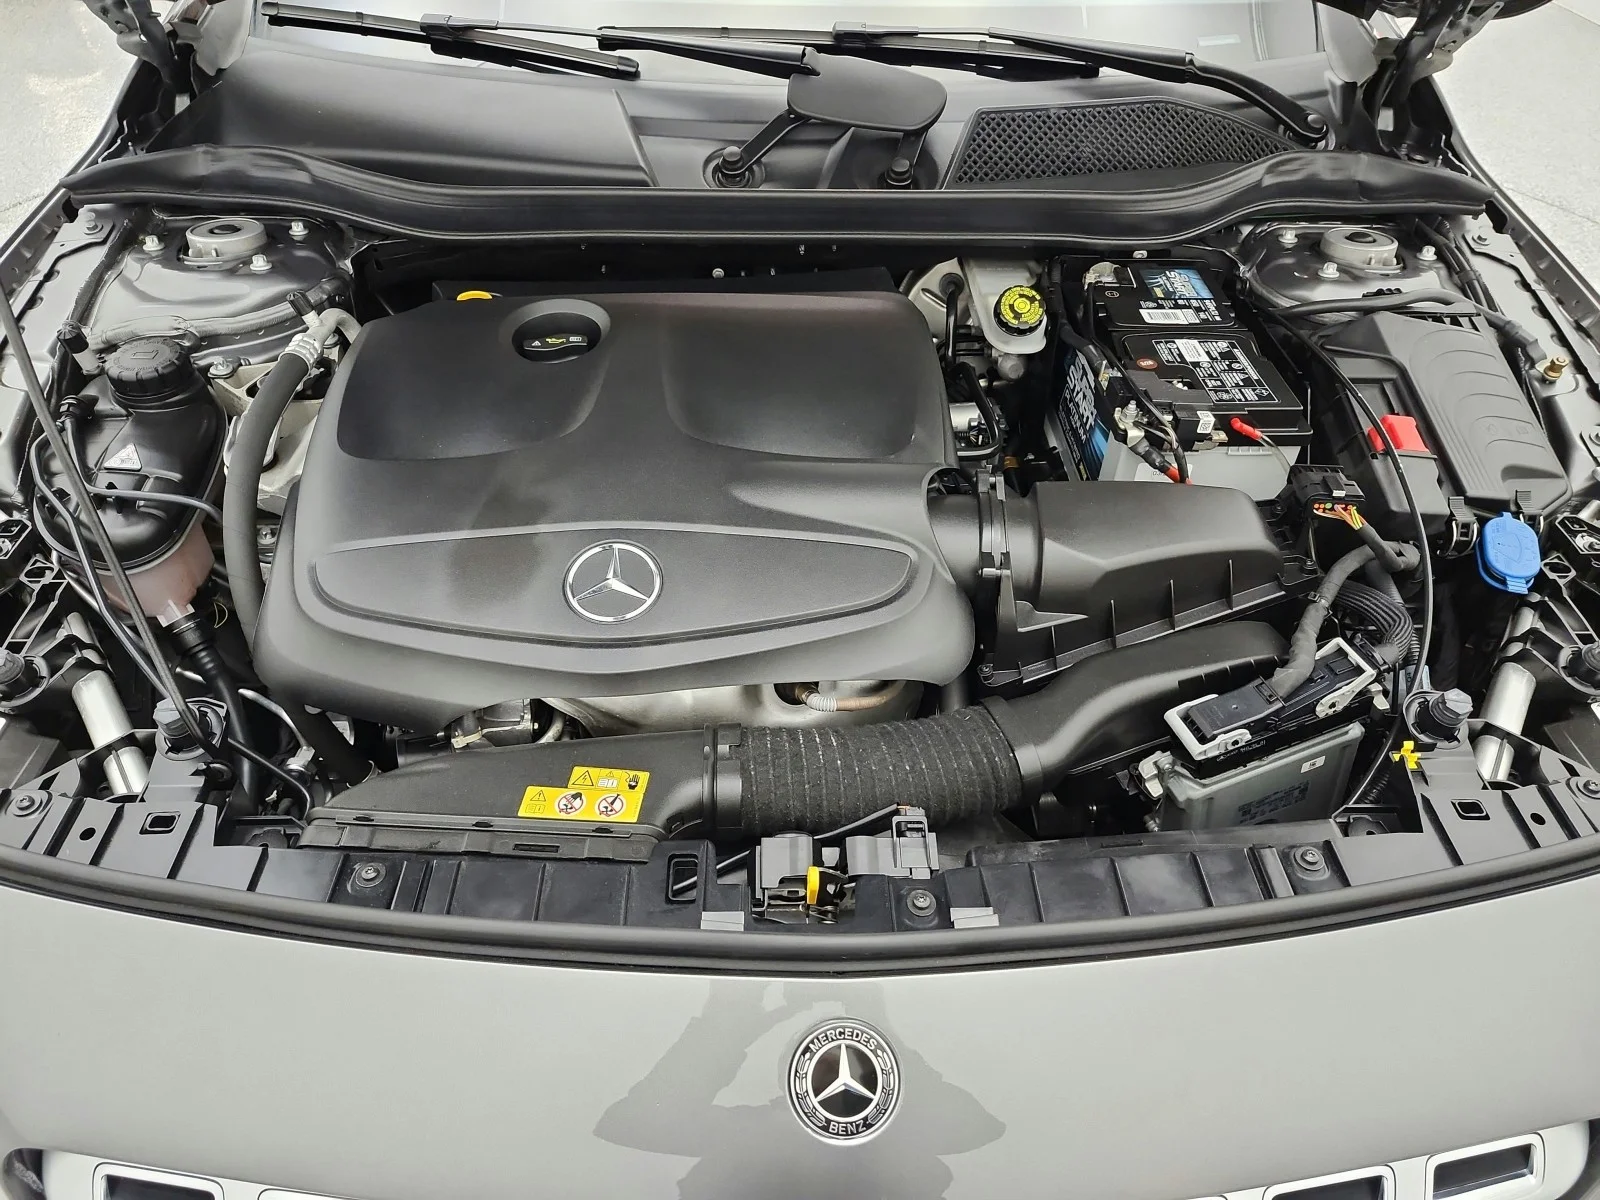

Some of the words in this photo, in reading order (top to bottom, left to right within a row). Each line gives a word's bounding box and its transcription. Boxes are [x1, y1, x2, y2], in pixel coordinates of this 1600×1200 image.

[1165, 270, 1190, 297] START
[1067, 365, 1095, 430] START
[1065, 389, 1086, 444] PLATINUM
[809, 1028, 877, 1053] MERCEDES
[829, 1120, 867, 1134] BENZ
